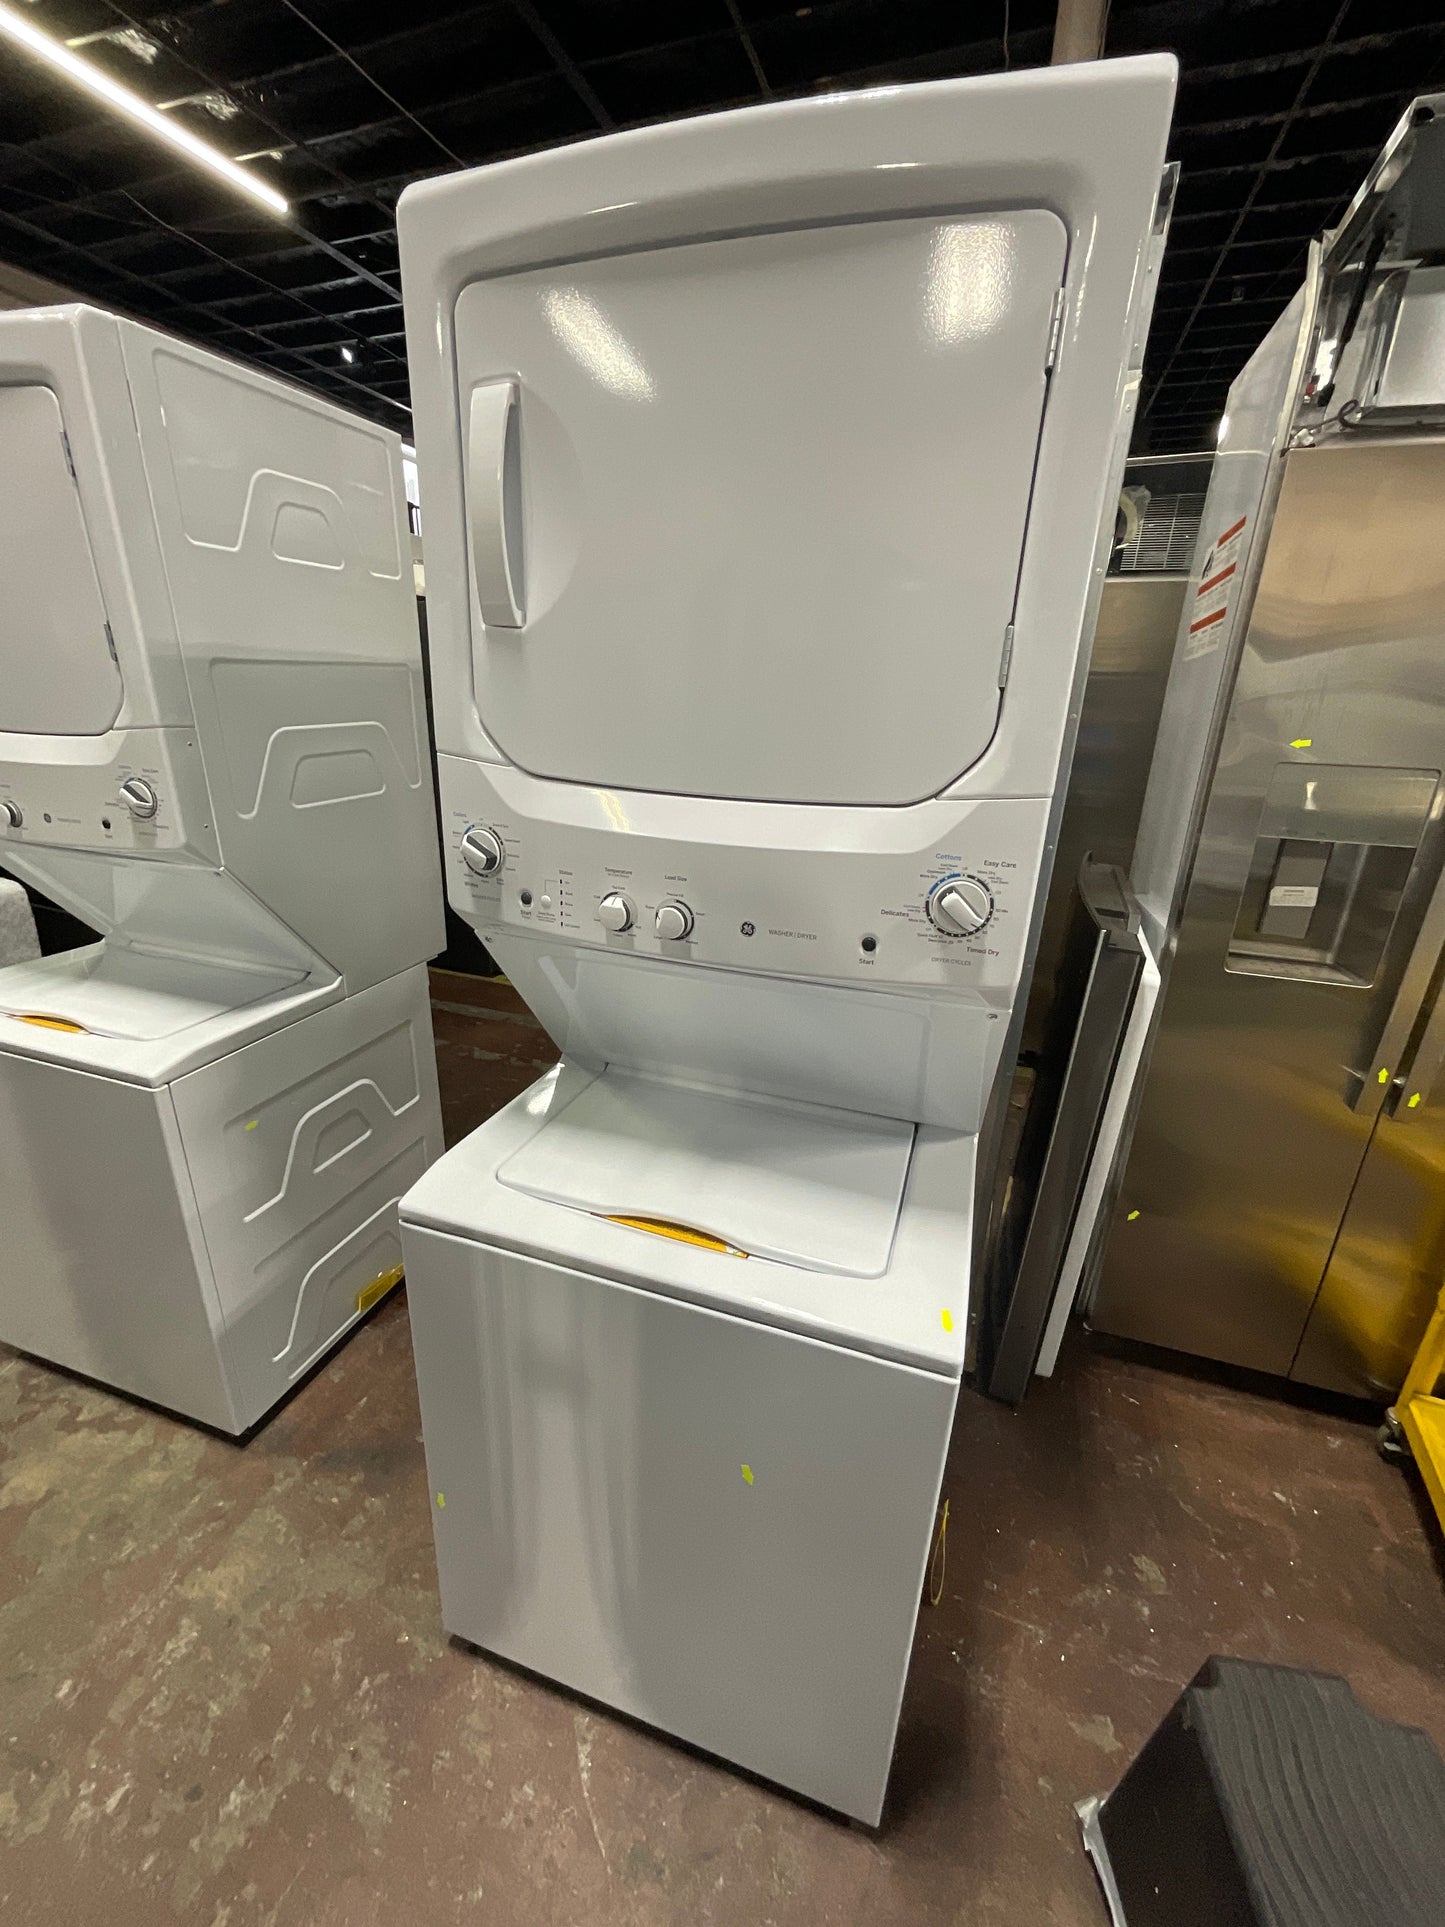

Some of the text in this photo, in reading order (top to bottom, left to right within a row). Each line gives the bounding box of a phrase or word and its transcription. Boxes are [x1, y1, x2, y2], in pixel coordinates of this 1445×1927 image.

[935, 852, 962, 861] Cottons
[983, 859, 999, 868] Easy
[604, 866, 633, 875] Temperature
[880, 909, 910, 918] Delicates
[966, 946, 1000, 957] Timed Dry
[859, 958, 875, 966] Start
